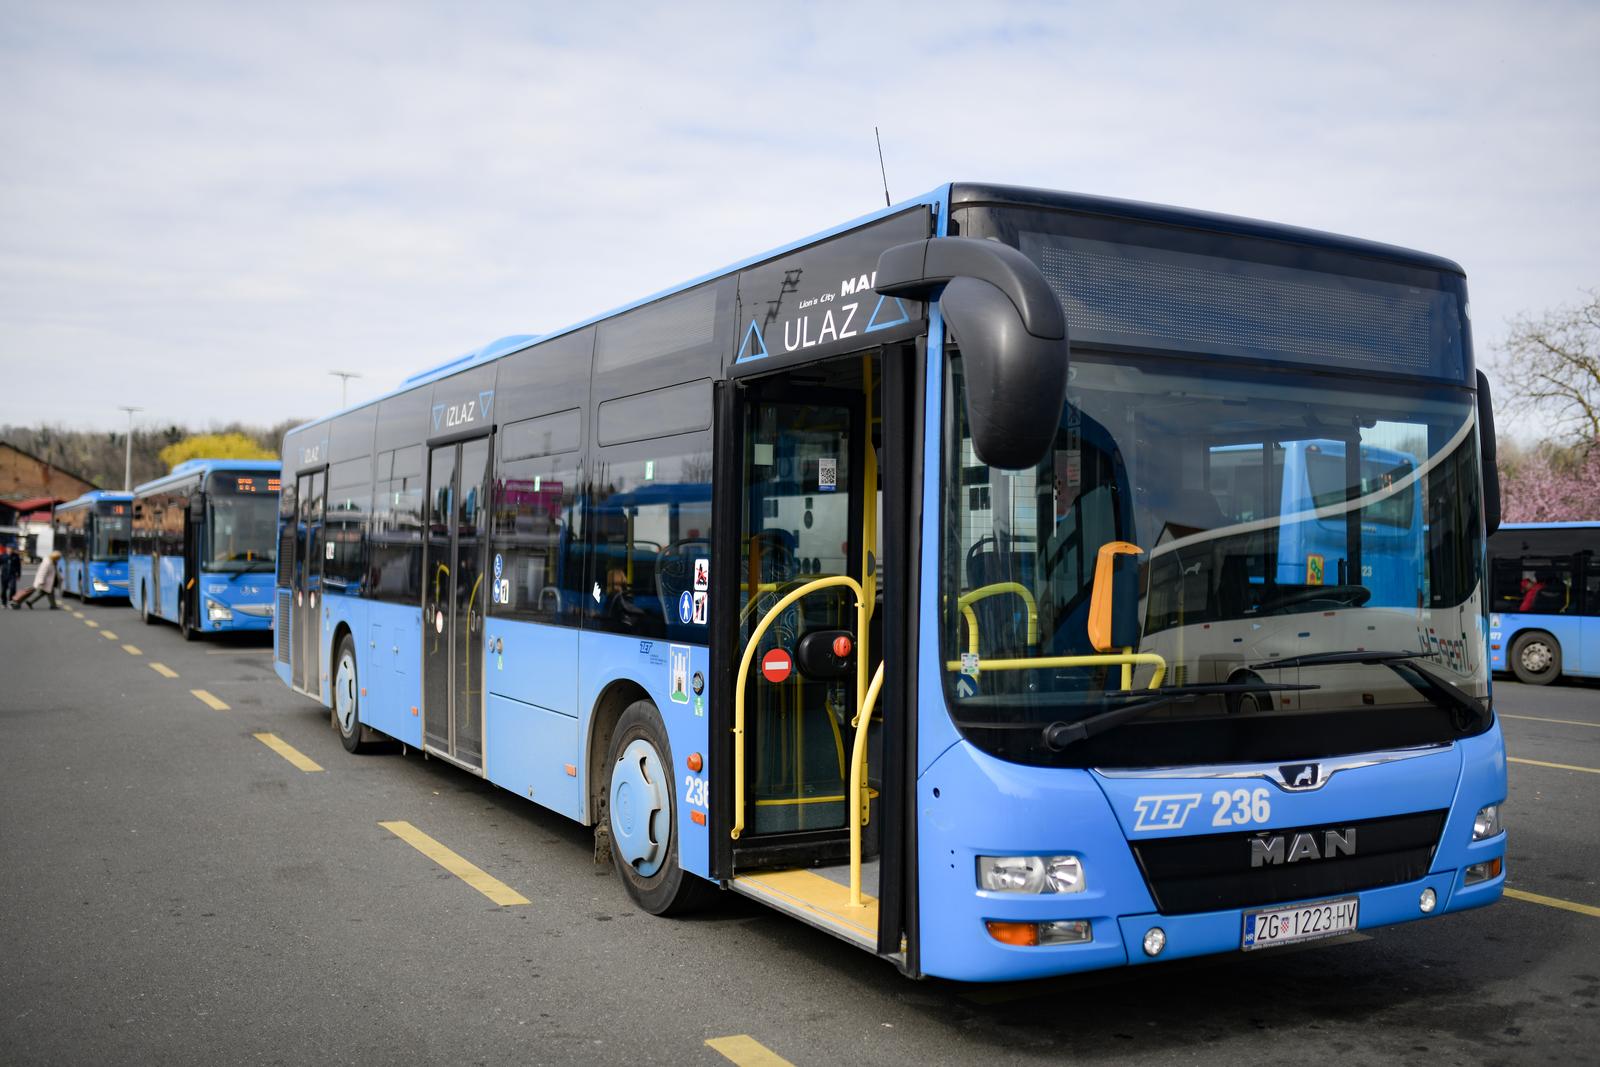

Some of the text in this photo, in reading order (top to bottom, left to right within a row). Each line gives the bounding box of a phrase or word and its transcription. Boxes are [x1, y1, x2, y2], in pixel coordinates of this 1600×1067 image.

[799, 297, 818, 309] Lion's
[820, 293, 836, 303] City
[784, 302, 859, 351] ULAZ
[446, 401, 475, 428] IZLAZ
[1133, 788, 1271, 831] ZET 236
[1249, 828, 1357, 868] MAN
[1256, 914, 1279, 941] ZG
